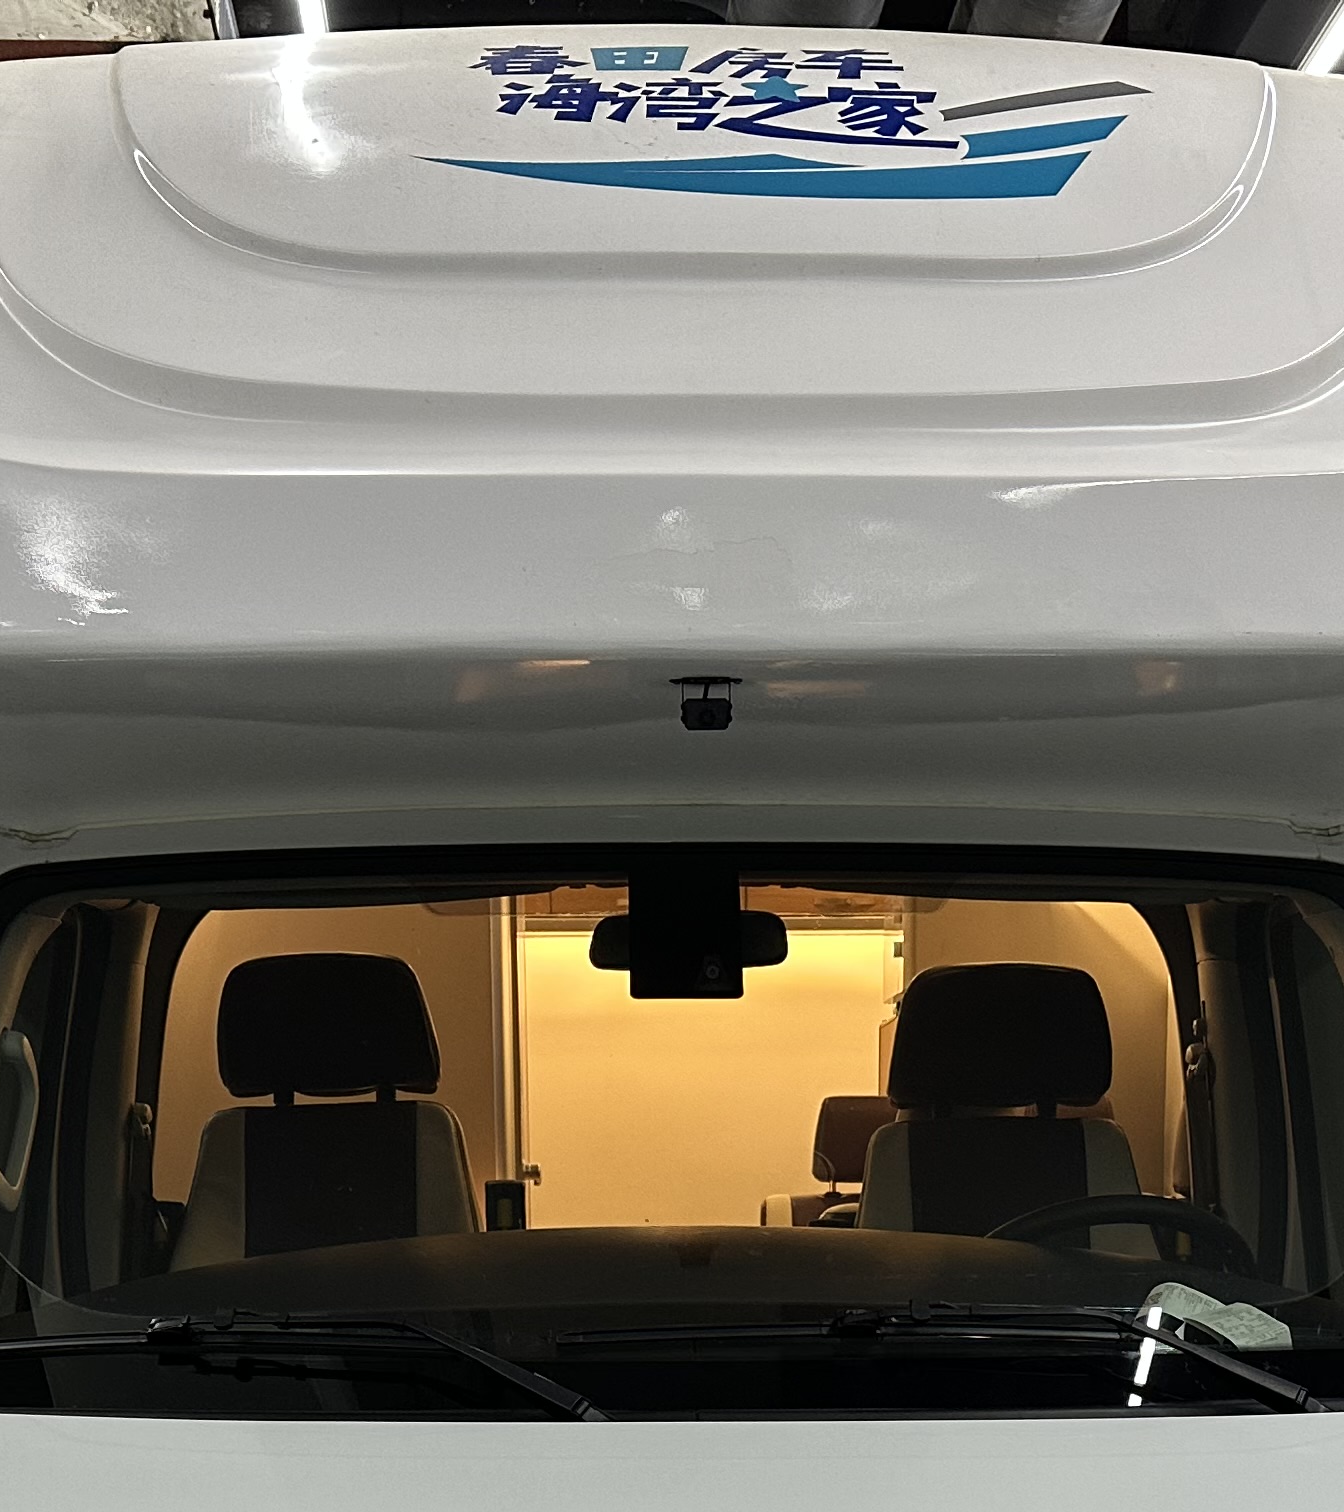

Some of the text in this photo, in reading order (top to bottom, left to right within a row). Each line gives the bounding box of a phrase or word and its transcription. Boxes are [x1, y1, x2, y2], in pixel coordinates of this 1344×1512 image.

[468, 45, 905, 80] 春田房车
[497, 74, 960, 149] 海湾之家
